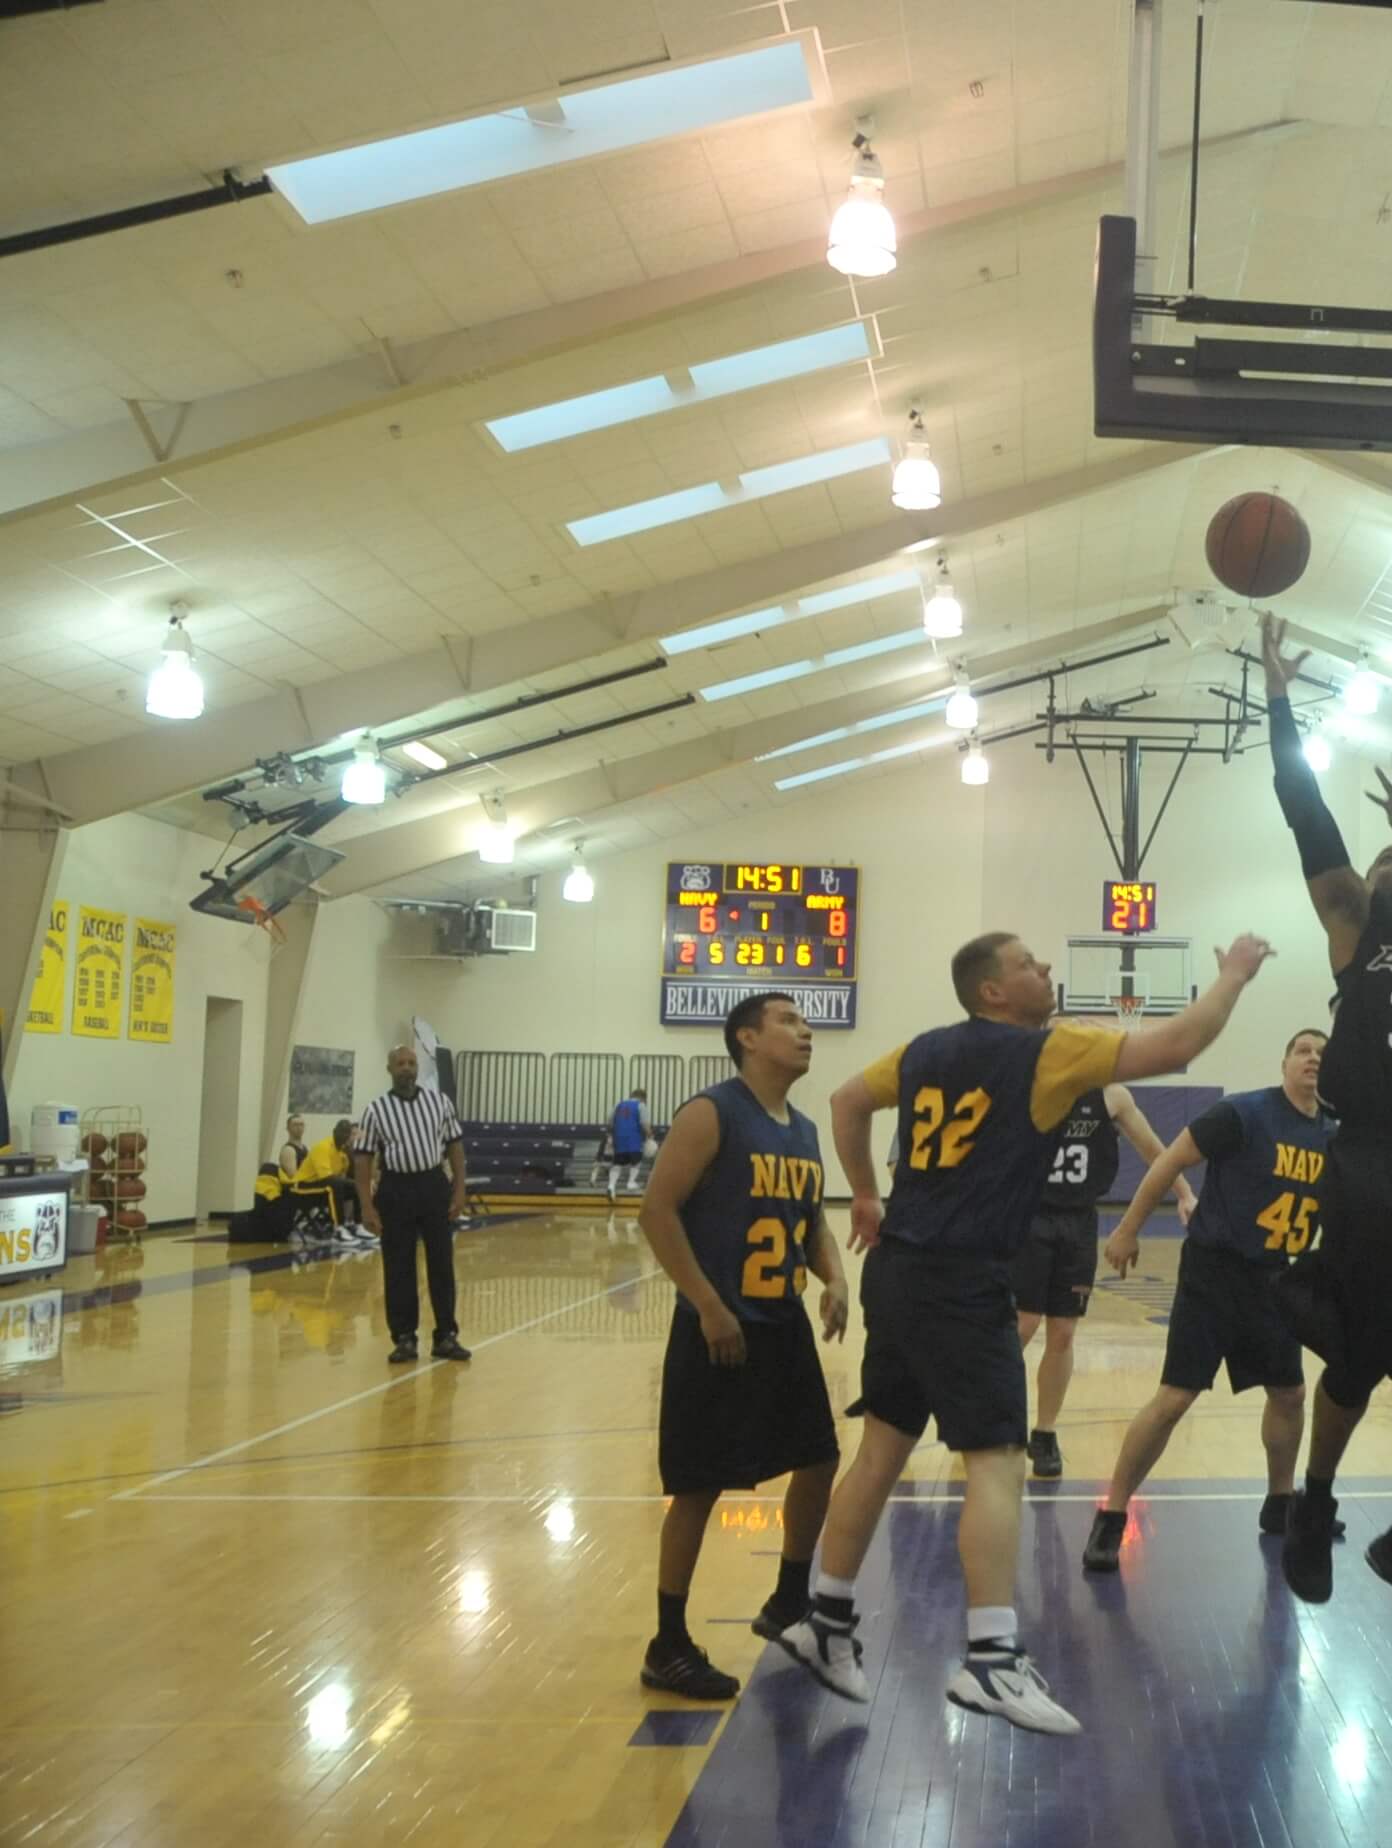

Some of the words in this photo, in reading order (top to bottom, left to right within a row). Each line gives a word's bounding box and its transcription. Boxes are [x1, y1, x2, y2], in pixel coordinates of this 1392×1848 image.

[737, 865, 800, 892] 14:51
[679, 891, 718, 906] NAVY
[806, 894, 845, 910] ARMY
[1112, 885, 1153, 902] 14:51
[699, 906, 717, 933] 6
[760, 911, 769, 931] 1
[829, 910, 847, 937] 8
[1112, 901, 1146, 929] 21
[680, 942, 697, 965] 2
[708, 942, 724, 965] 5
[735, 942, 765, 965] 23
[775, 944, 784, 965] 1
[795, 943, 812, 967] 6
[836, 944, 844, 966] 1
[910, 1086, 993, 1170] 22
[1272, 1142, 1325, 1185] NAV
[750, 1153, 822, 1204] NAVY
[1255, 1191, 1320, 1254] 45
